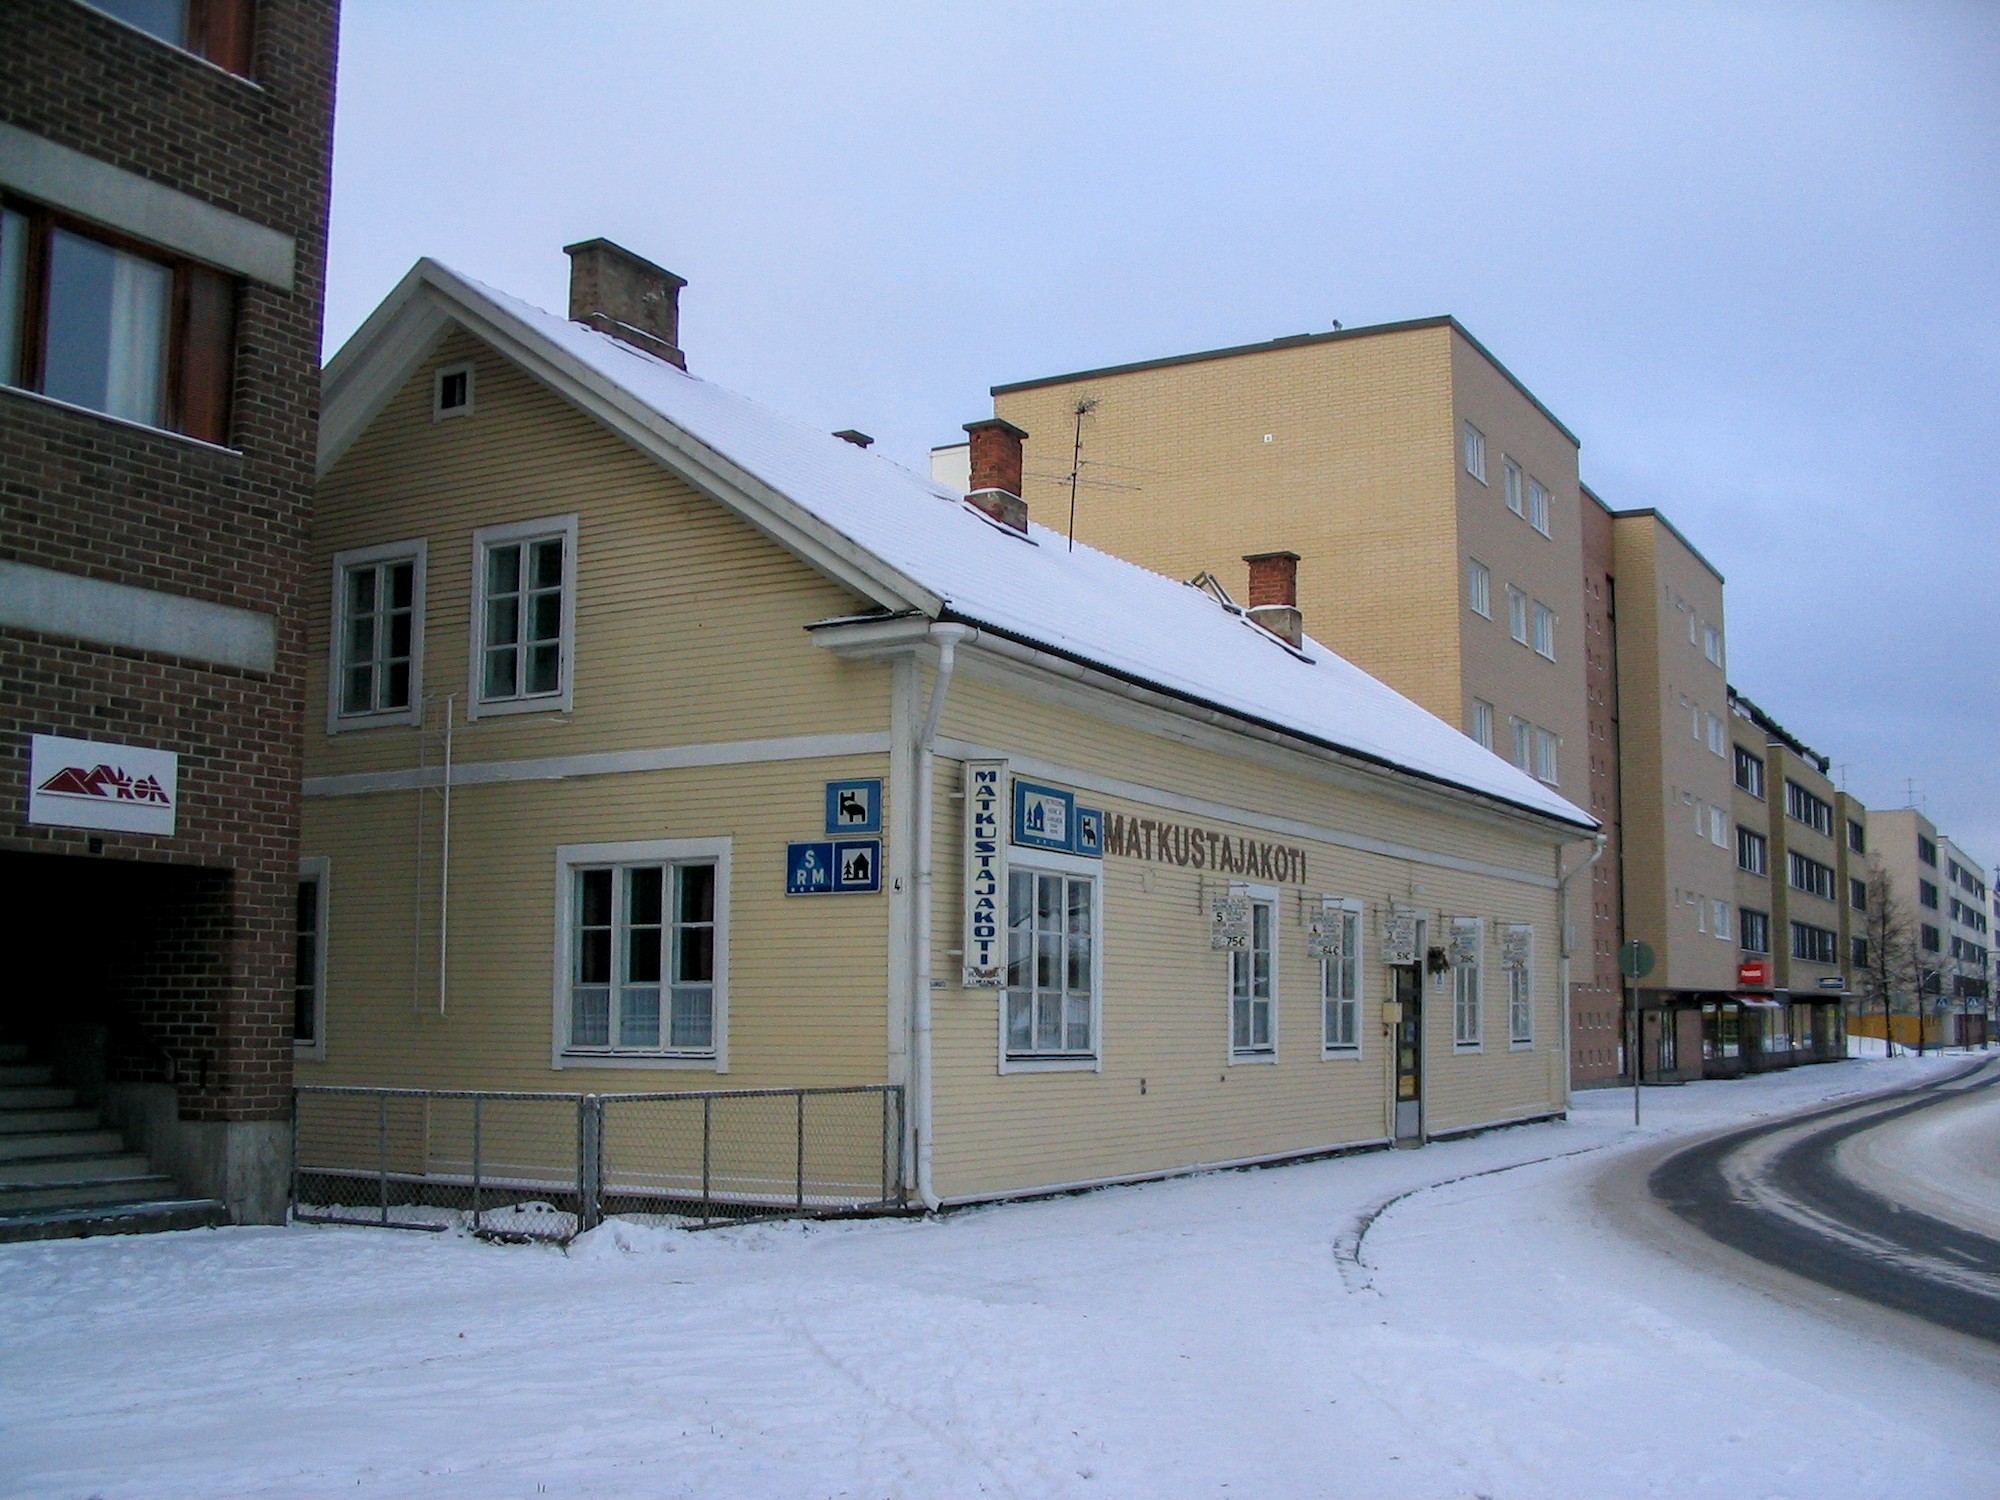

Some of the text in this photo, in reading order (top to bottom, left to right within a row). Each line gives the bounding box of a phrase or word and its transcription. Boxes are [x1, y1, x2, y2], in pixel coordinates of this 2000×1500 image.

[974, 771, 997, 965] MATKUSTAJAKOTI
[1104, 812, 1306, 884] MATKUSTAJAKOTI
[894, 877, 901, 891] 4
[1216, 911, 1223, 922] 5
